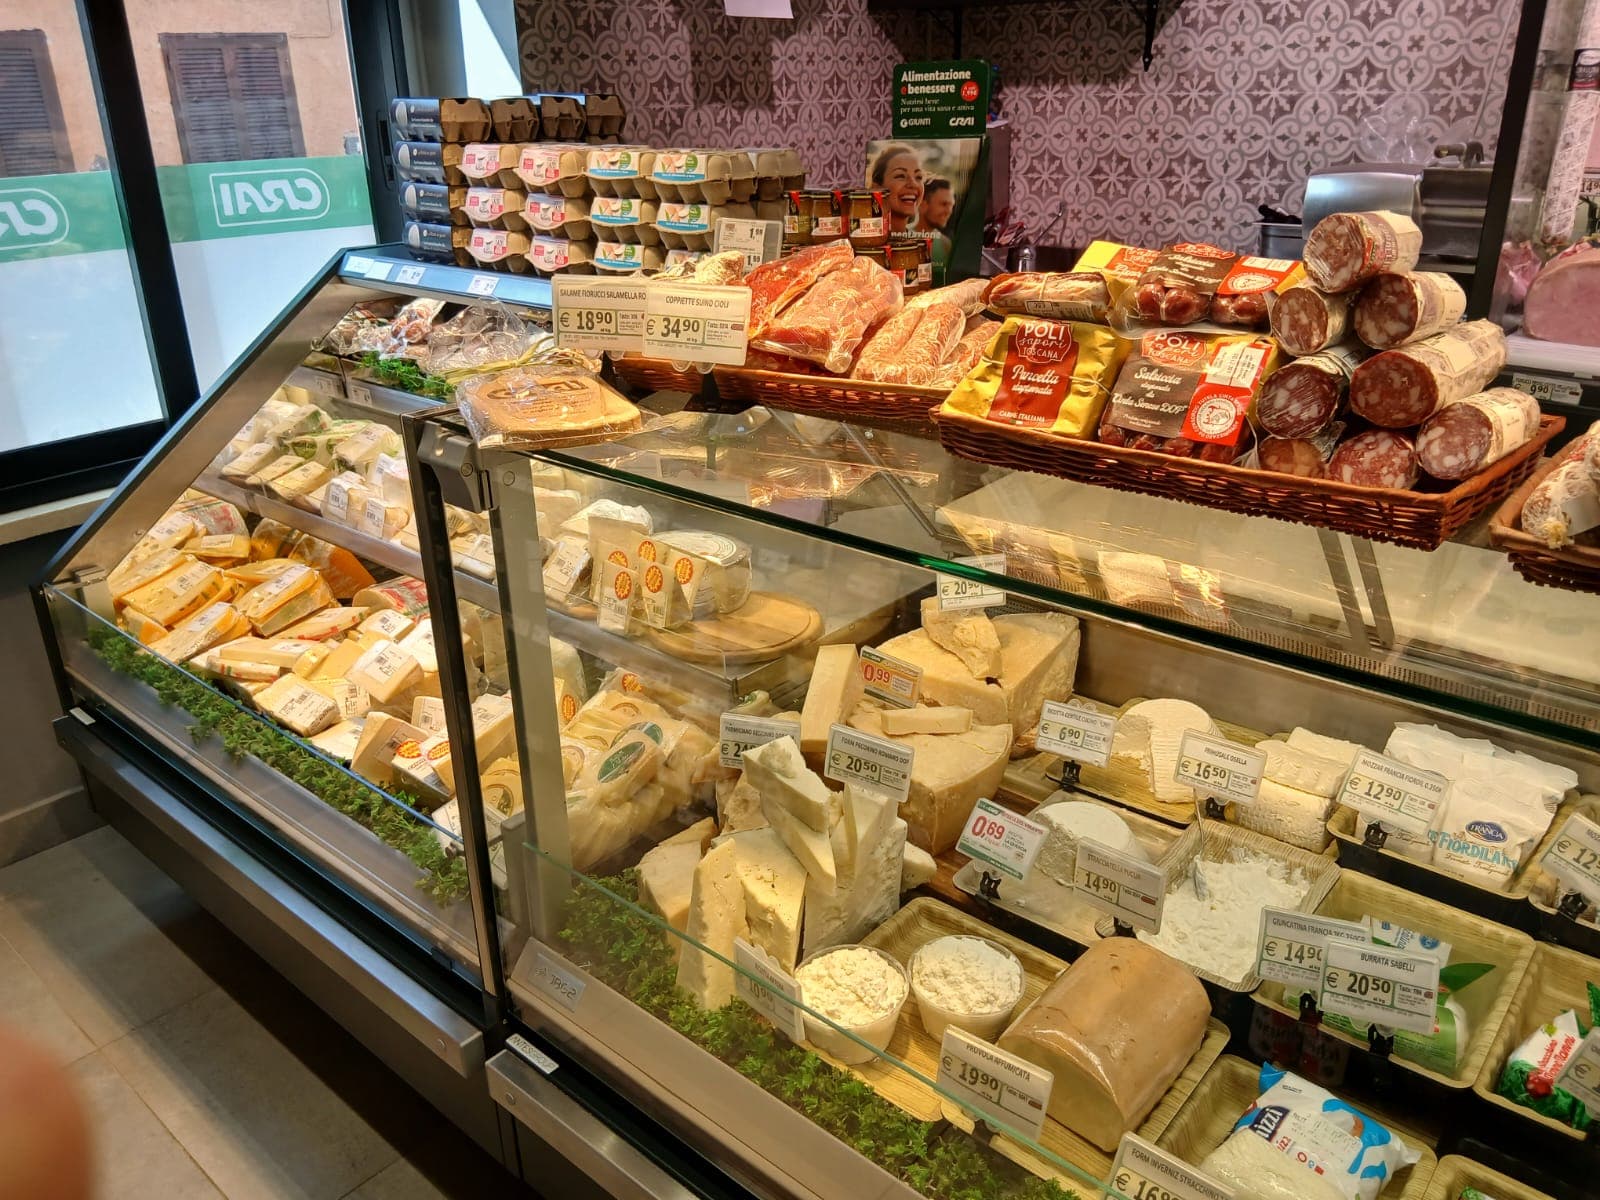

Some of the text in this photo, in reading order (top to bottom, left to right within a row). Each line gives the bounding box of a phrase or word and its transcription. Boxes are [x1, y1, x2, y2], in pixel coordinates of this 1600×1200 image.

[901, 69, 971, 82] Alimentazione
[908, 84, 956, 95] benessere
[949, 117, 975, 126] CRAI
[560, 289, 581, 298] SALAME
[582, 290, 605, 299] FIORUCCI
[606, 291, 638, 300] SALAMELLA
[666, 295, 729, 309] COPPIETTE SUINO CIOLI
[560, 312, 570, 328] €
[647, 319, 656, 336] €
[1024, 322, 1065, 340] POLI
[1020, 337, 1067, 350] sapori
[1155, 332, 1201, 351] POLI
[1023, 347, 1059, 360] TOSCANA
[1011, 364, 1060, 385] Pancetta
[864, 664, 890, 683] 0,99
[1041, 723, 1050, 734] €
[722, 743, 729, 755] €
[832, 753, 840, 765] €
[1181, 760, 1191, 772] €
[1349, 777, 1361, 790] €
[971, 815, 1005, 840] 0,69
[1264, 941, 1278, 956] €
[1360, 953, 1416, 973] BURRATA SABELLI
[1326, 972, 1340, 988] €
[942, 1056, 953, 1071] €
[966, 1043, 1031, 1081] PROVOLA AFFUMICATA
[1115, 1172, 1131, 1191] €
[1131, 1148, 1220, 1200] FORM INVERNIZ STRACCHINO
